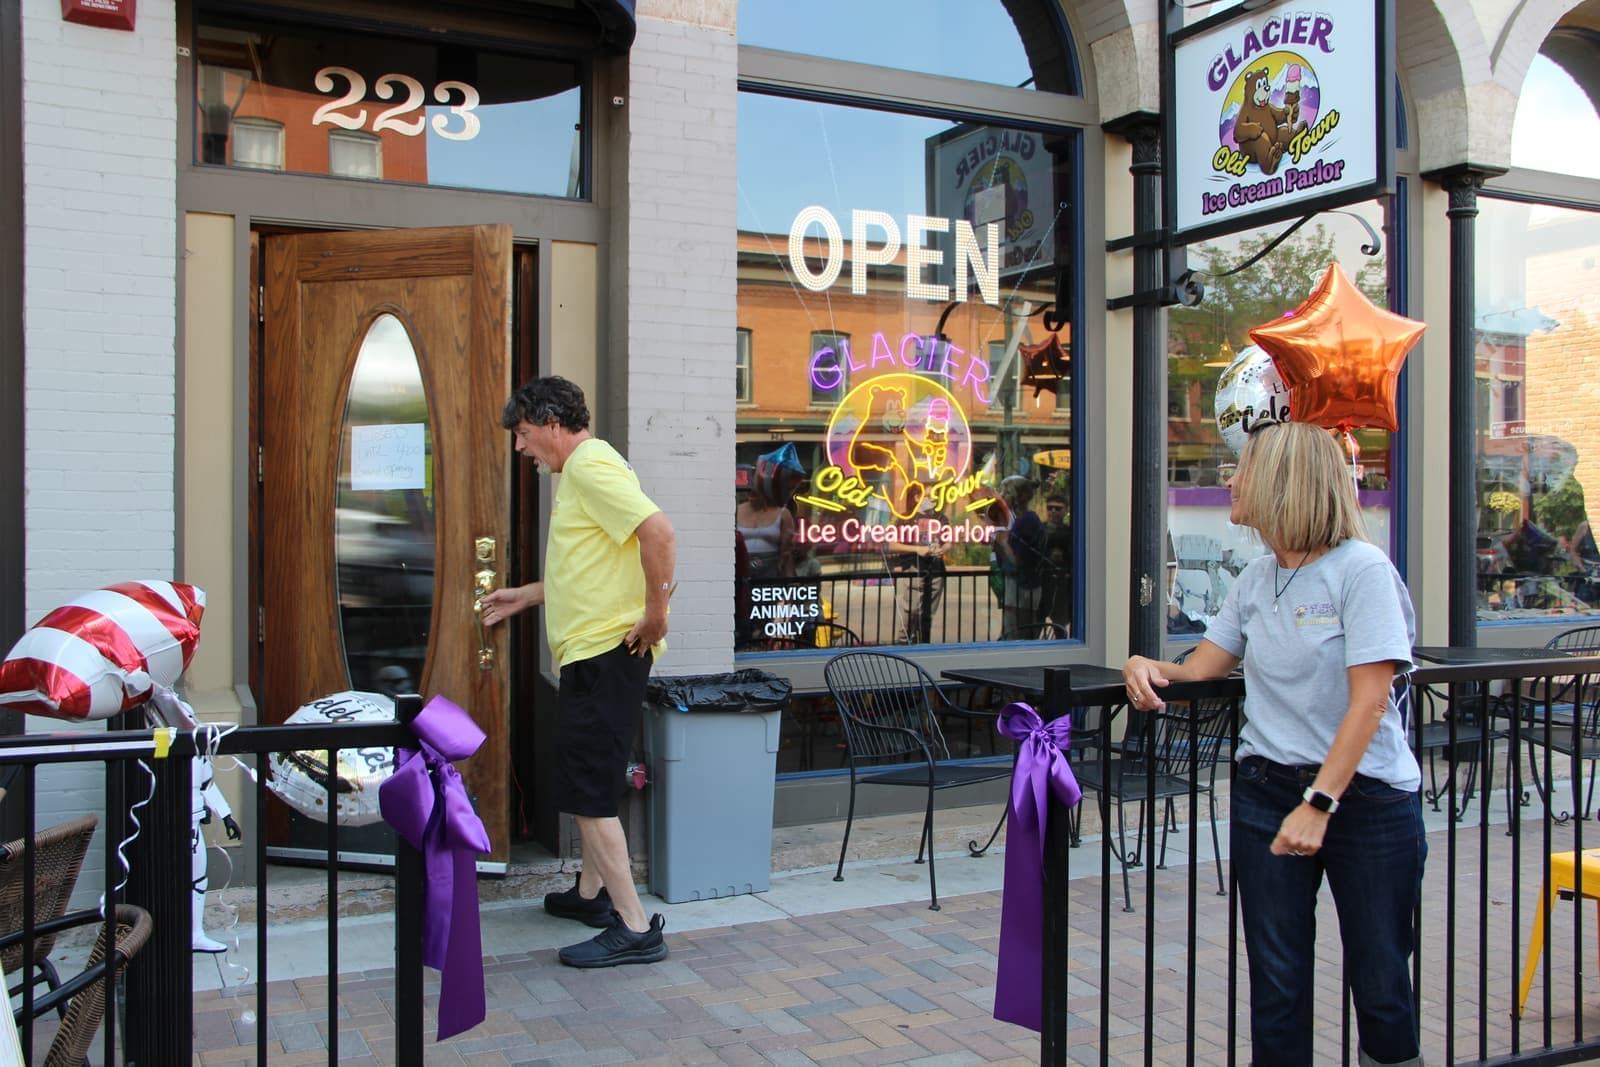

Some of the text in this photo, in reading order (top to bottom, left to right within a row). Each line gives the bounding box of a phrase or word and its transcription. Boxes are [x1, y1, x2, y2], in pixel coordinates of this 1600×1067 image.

[1206, 11, 1335, 93] GLACIER
[312, 66, 480, 141] 223
[1212, 108, 1341, 177] Old Town
[1202, 158, 1345, 216] Ice Cream Parlor
[788, 205, 999, 304] OPEN
[809, 331, 993, 404] GLACIER
[816, 465, 875, 507] Old
[798, 518, 995, 544] Ice Cream Parlor
[749, 603, 820, 620] ANIMALS
[751, 586, 818, 602] SERVICE
[764, 621, 806, 637] ONLY
